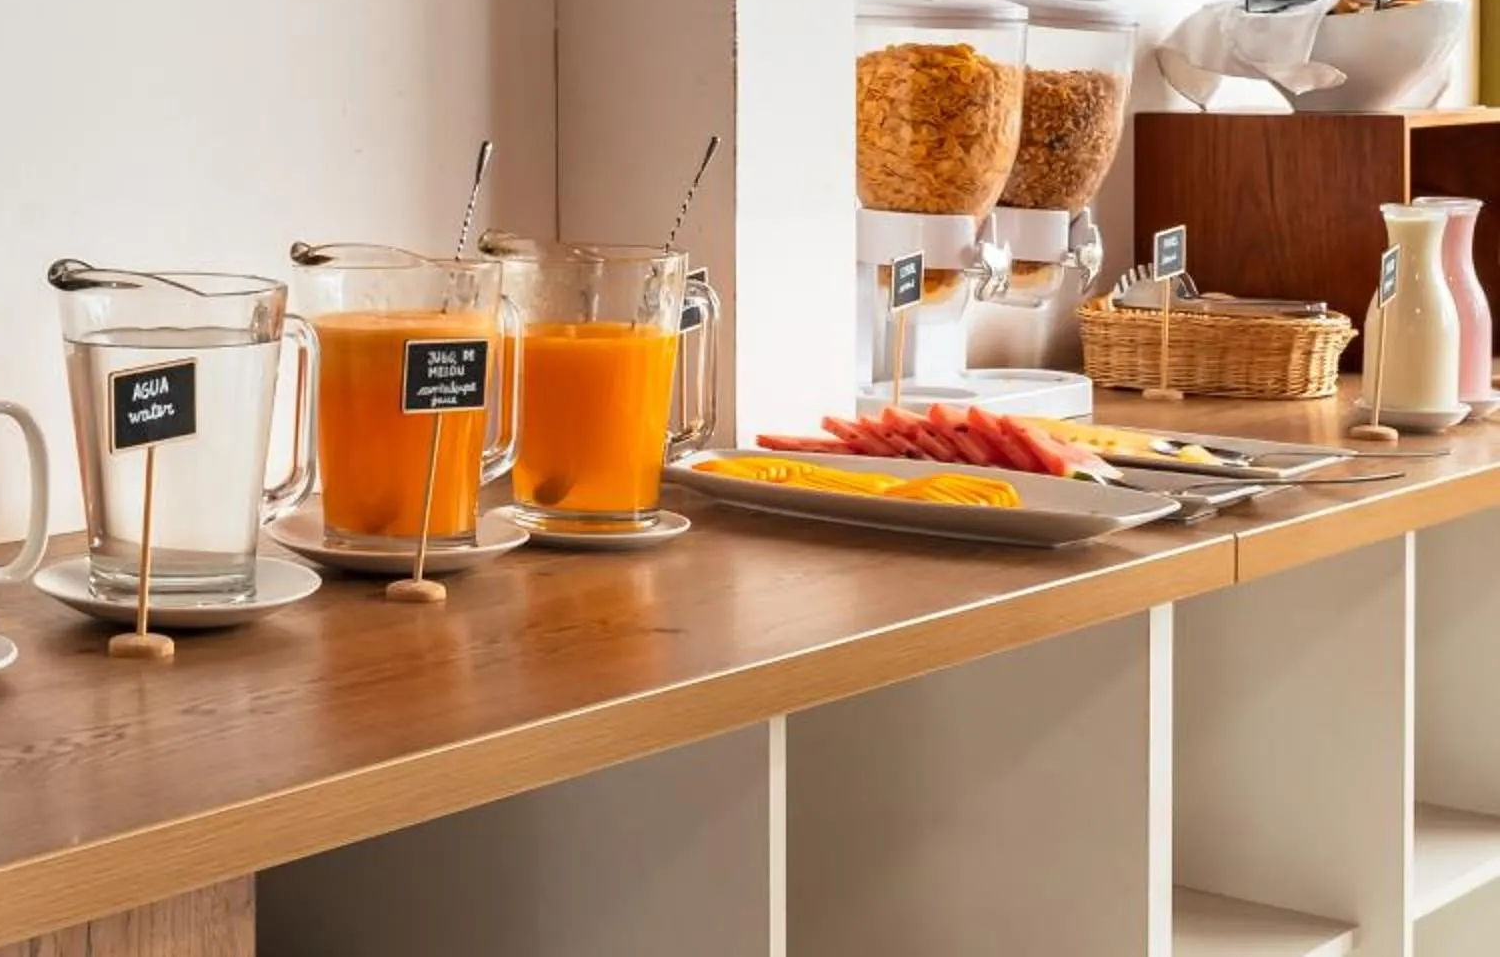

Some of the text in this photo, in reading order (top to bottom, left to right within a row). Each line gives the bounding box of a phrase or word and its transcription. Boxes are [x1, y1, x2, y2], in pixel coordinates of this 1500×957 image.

[462, 349, 475, 362] DE
[132, 376, 169, 402] AGUA
[127, 403, 175, 424] water
